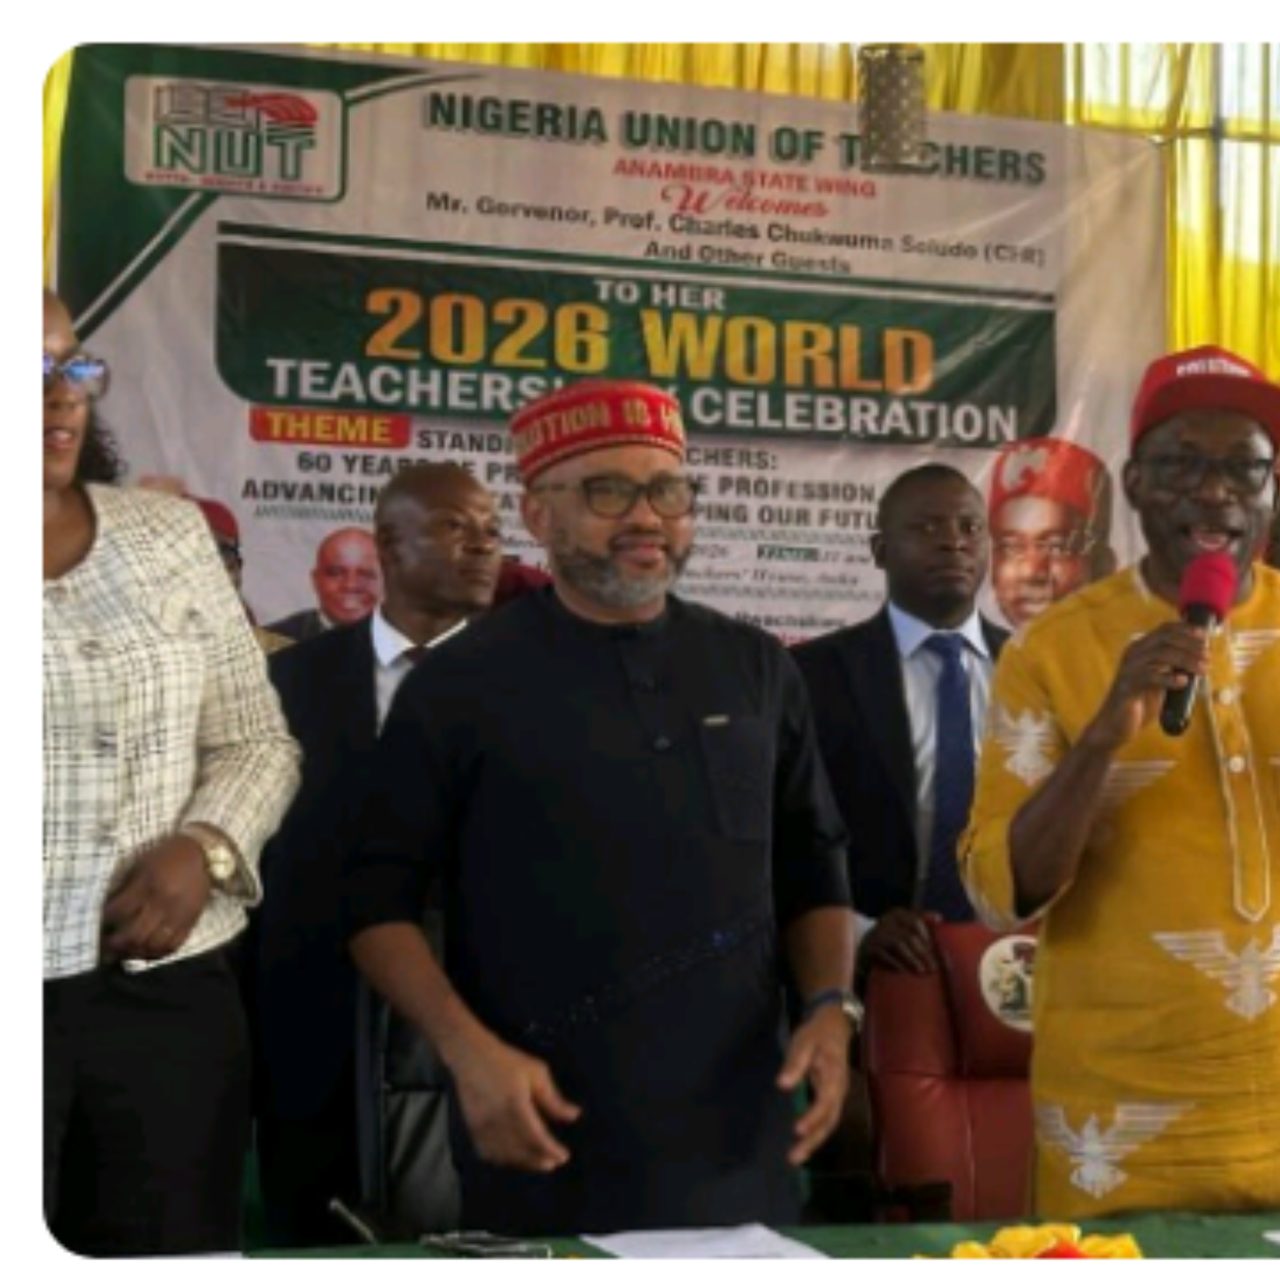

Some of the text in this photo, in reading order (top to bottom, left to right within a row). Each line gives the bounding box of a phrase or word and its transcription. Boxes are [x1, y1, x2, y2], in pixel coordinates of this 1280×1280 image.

[154, 122, 318, 181] NUT
[427, 92, 1046, 183] NIGERIA UNION OF TCHERS
[612, 158, 876, 197] ANAMBRA STATE WING
[426, 192, 467, 213] Mr.
[603, 206, 662, 231] Prof.
[669, 214, 761, 240] Charles
[767, 223, 894, 249] Chukwuma
[644, 242, 691, 260] And
[699, 244, 763, 266] Other
[595, 279, 726, 310] TO HER
[365, 287, 936, 394] 2026 WORLD
[266, 411, 391, 443] THEME
[691, 389, 1018, 442] CELEBRATION
[297, 452, 332, 474] 60
[681, 447, 778, 470] CHERS:
[718, 476, 876, 502] PROFESSION
[757, 505, 811, 526] OUR
[818, 508, 878, 530] FUTU
